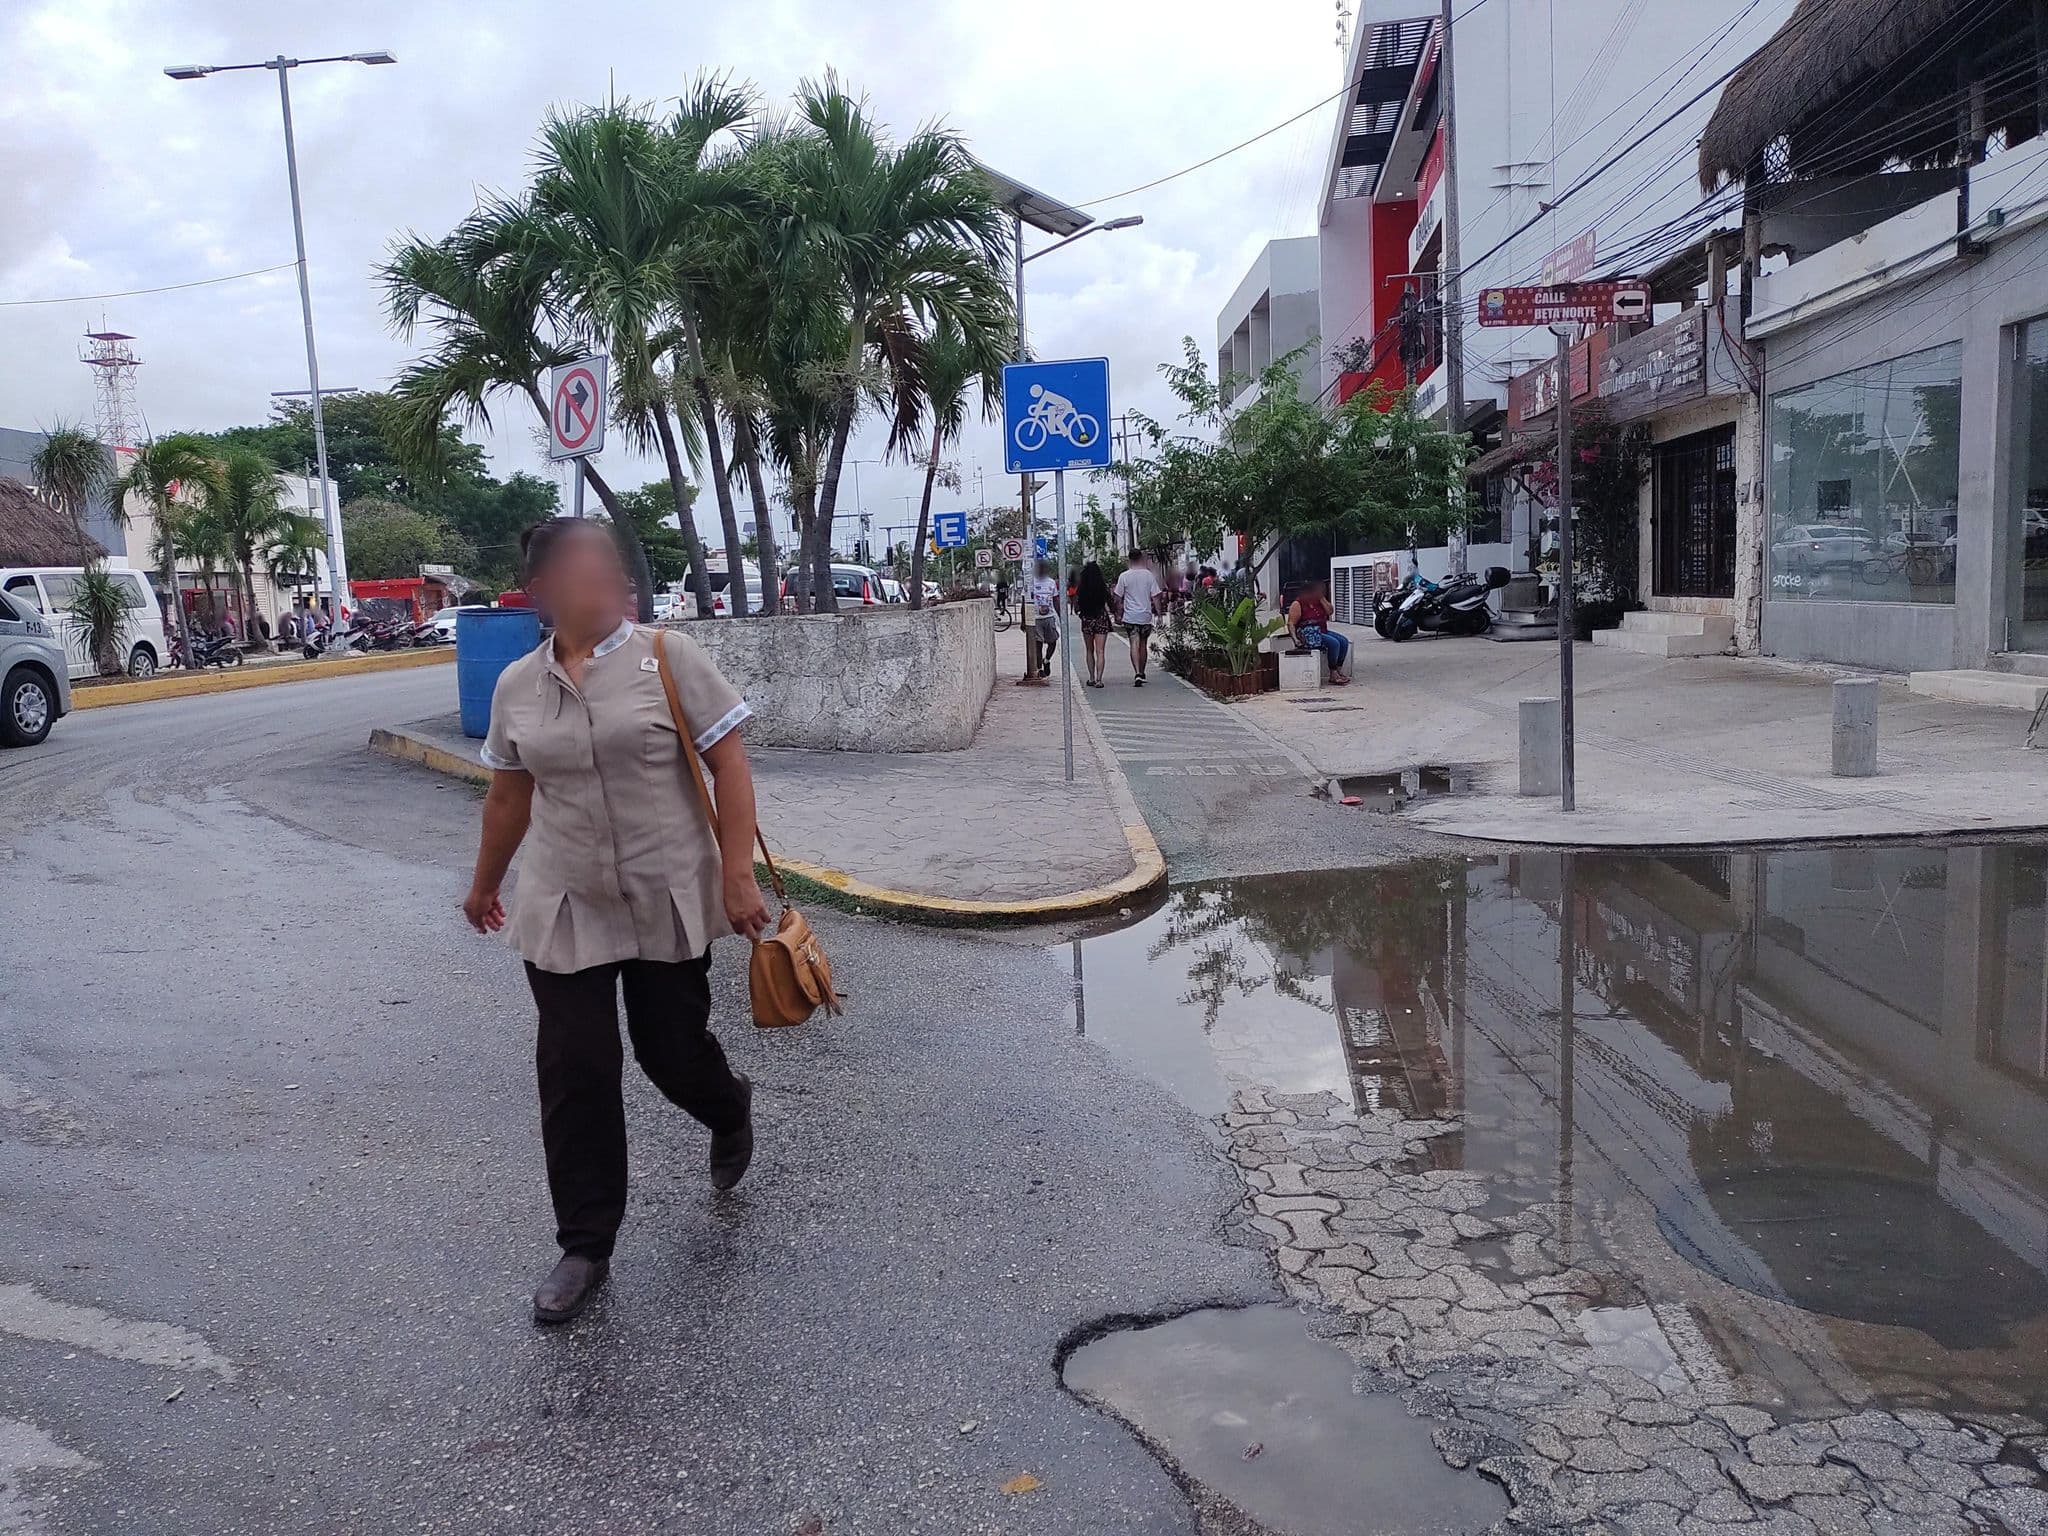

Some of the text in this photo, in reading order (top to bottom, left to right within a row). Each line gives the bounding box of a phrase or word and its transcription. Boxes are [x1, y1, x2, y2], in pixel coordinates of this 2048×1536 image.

[1534, 292, 1566, 304] CALLE
[1534, 306, 1597, 320] BETA NORTE
[941, 518, 961, 542] E
[26, 621, 42, 634] F-13
